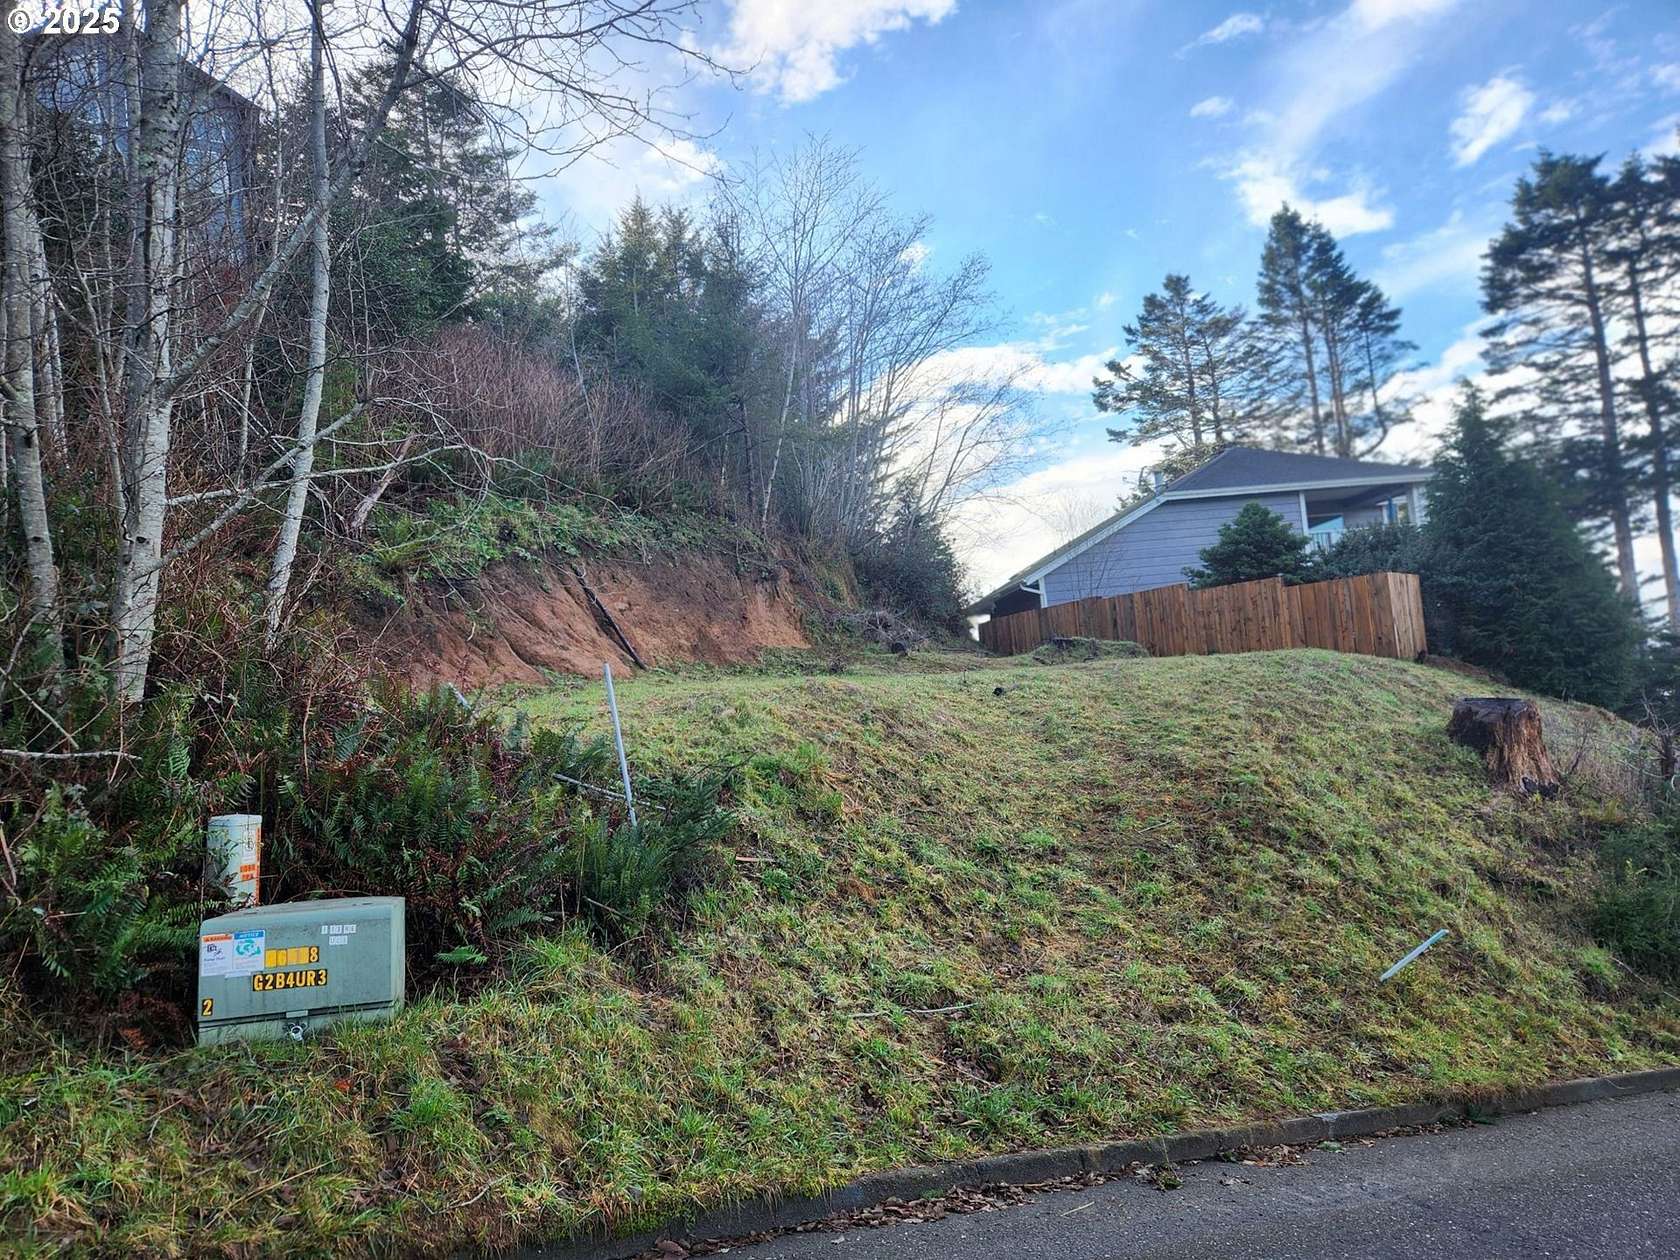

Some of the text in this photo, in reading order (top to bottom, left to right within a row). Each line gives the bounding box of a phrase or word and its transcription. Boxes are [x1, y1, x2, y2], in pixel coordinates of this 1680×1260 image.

[310, 947, 318, 962] 8
[254, 970, 327, 991] G2B4UR3
[203, 999, 212, 1016] 2
